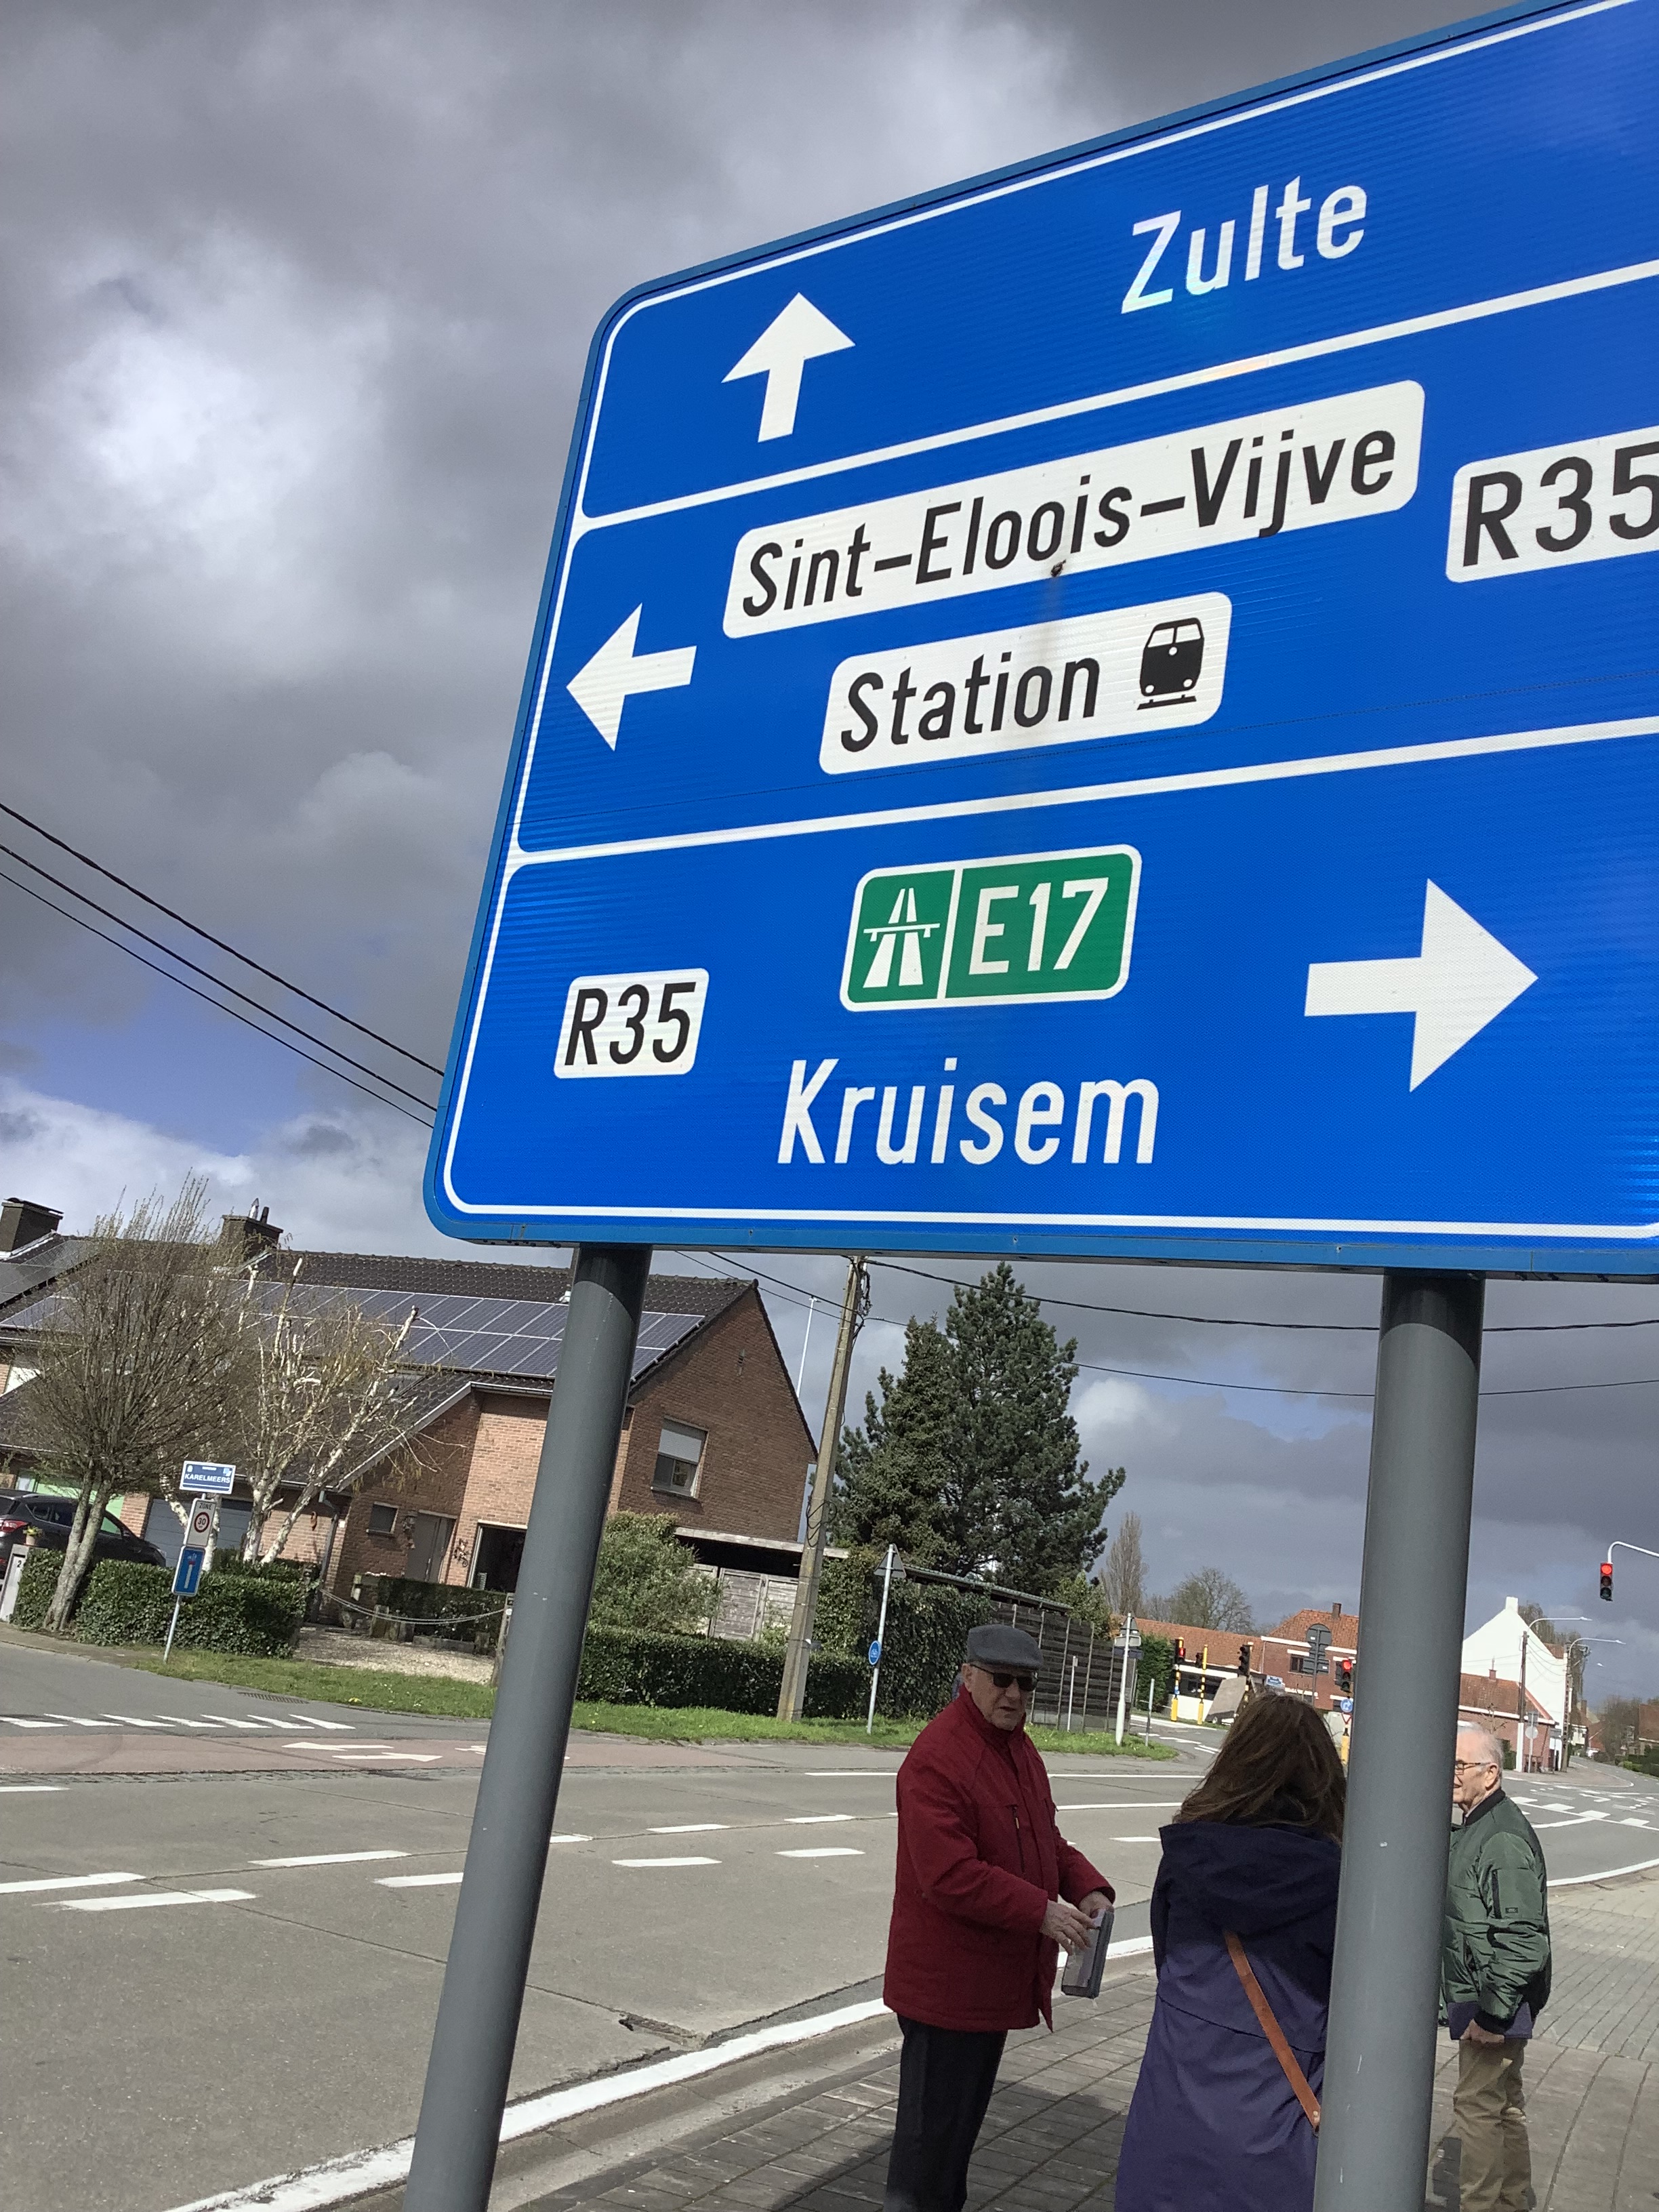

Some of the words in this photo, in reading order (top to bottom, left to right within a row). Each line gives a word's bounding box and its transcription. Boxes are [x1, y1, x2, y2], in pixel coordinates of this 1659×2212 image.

[1121, 176, 1368, 314] Zulte
[743, 429, 1396, 617] Sint-Eloois-Vijve
[1463, 441, 1659, 567] R35
[841, 651, 1100, 752] Station
[968, 877, 1109, 975] E17
[565, 981, 697, 1066] R35
[777, 1057, 1160, 1165] Kruisem
[184, 1473, 230, 1483] KARELMEERS
[197, 1517, 207, 1525] 30
[198, 1502, 212, 1511] ZONE
